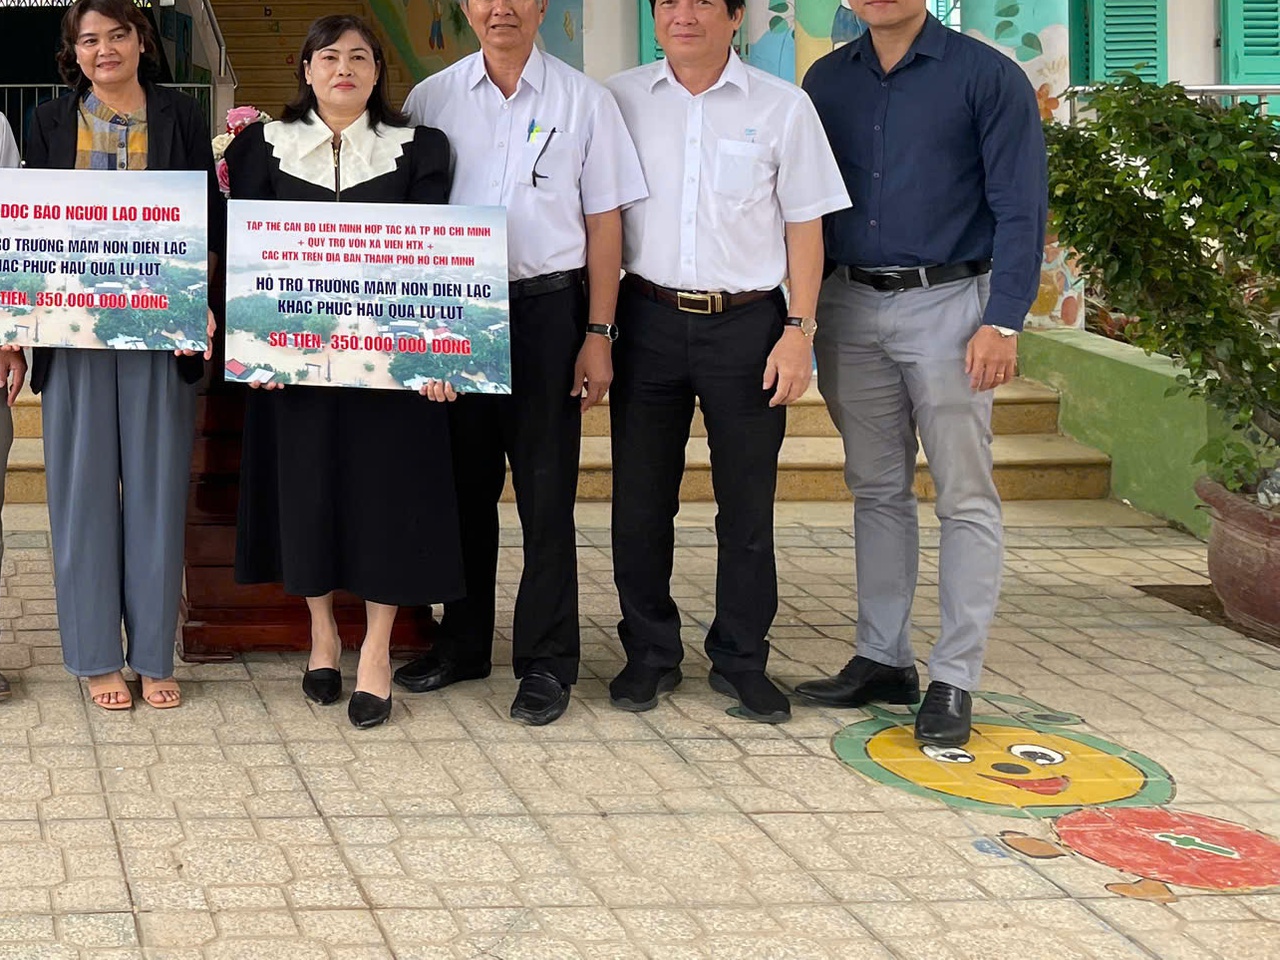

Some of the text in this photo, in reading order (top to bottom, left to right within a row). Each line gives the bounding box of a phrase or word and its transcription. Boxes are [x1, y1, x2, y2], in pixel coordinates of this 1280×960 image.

[264, 7, 272, 17] b
[112, 206, 137, 221] LAO
[339, 224, 362, 233] MINH
[420, 226, 430, 235] TP
[467, 227, 491, 237] MINH
[103, 240, 128, 254] NON
[406, 240, 424, 250] HTX
[282, 251, 299, 261] HTX
[451, 256, 475, 266] MINH
[401, 282, 428, 296] NON
